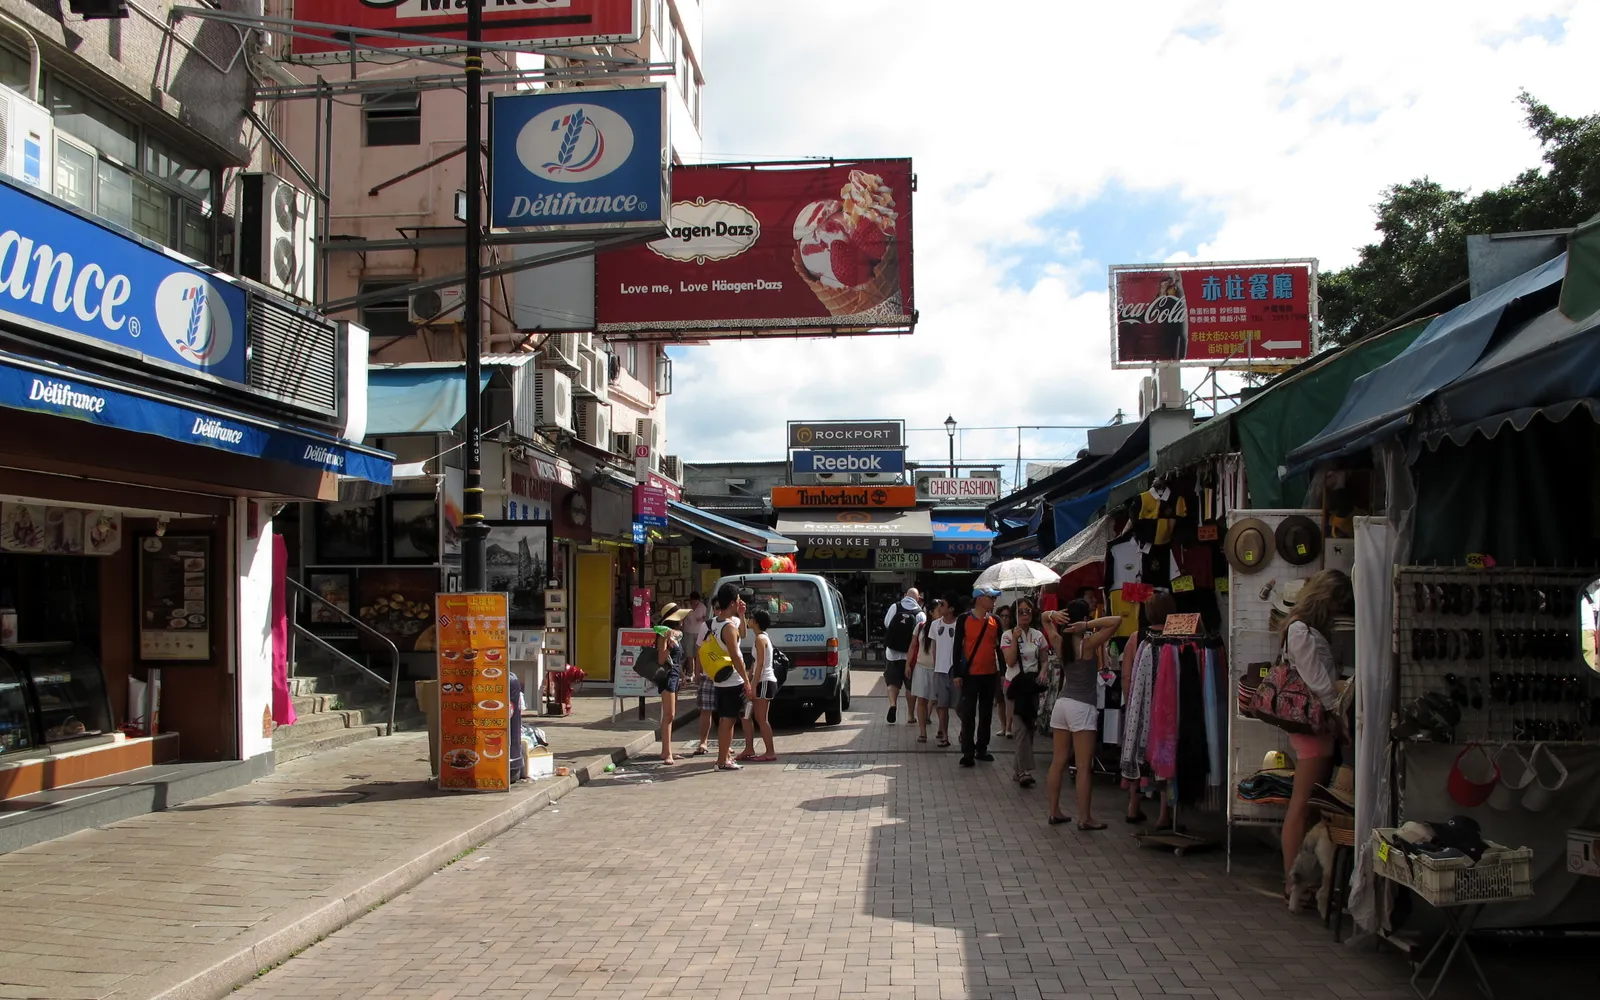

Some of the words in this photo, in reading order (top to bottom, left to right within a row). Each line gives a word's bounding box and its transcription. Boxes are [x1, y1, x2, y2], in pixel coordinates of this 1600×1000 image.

[671, 220, 755, 243] agen-Dazs
[620, 282, 650, 295] Love
[651, 284, 673, 296] me,
[680, 280, 709, 293] Love
[1201, 273, 1293, 302] 赤柱餐廳
[192, 417, 244, 444] Délifrance
[815, 429, 891, 440] ROCKPORT
[303, 444, 345, 467] Délifrance
[812, 454, 883, 471] Reebok
[959, 480, 996, 496] FASHION
[797, 489, 869, 505] Timberland
[808, 537, 842, 546] KONG
[846, 538, 870, 547] KEE
[948, 543, 983, 551] KONG
[878, 553, 905, 563] SPORTS
[794, 633, 825, 643] 27230000
[802, 667, 824, 682] 291
